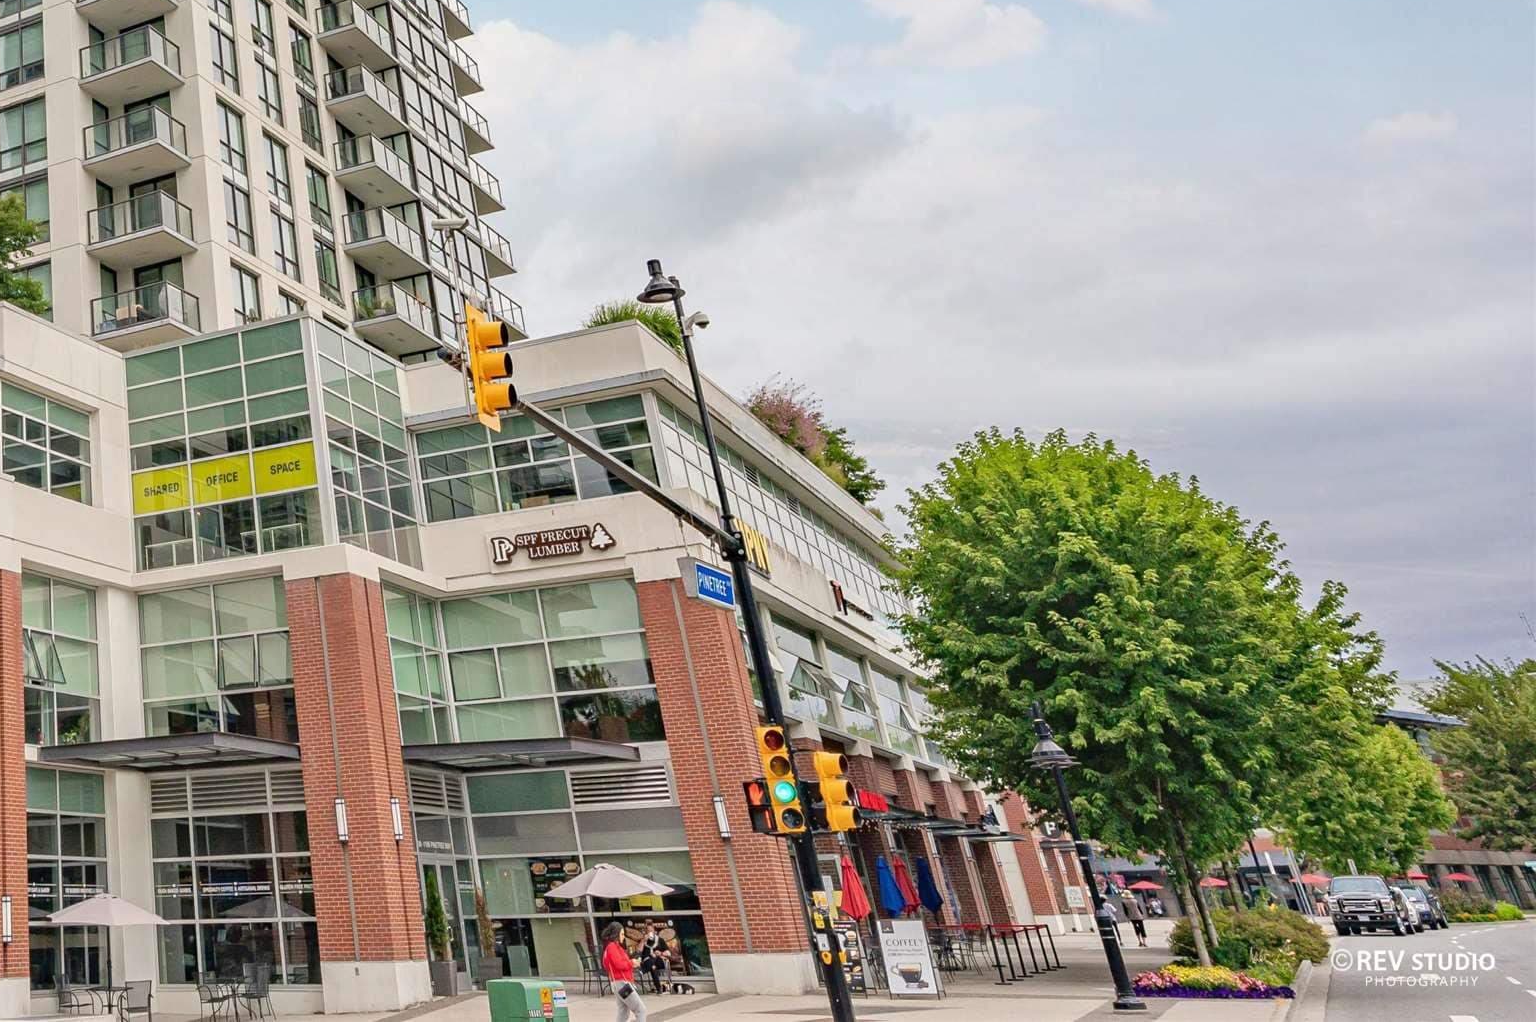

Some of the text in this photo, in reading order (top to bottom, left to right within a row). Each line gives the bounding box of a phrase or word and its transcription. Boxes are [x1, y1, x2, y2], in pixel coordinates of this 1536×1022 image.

[144, 460, 301, 497] SHARED OFFICE SPACE
[517, 526, 588, 547] SPF PRECUT
[529, 541, 580, 558] LUMBER
